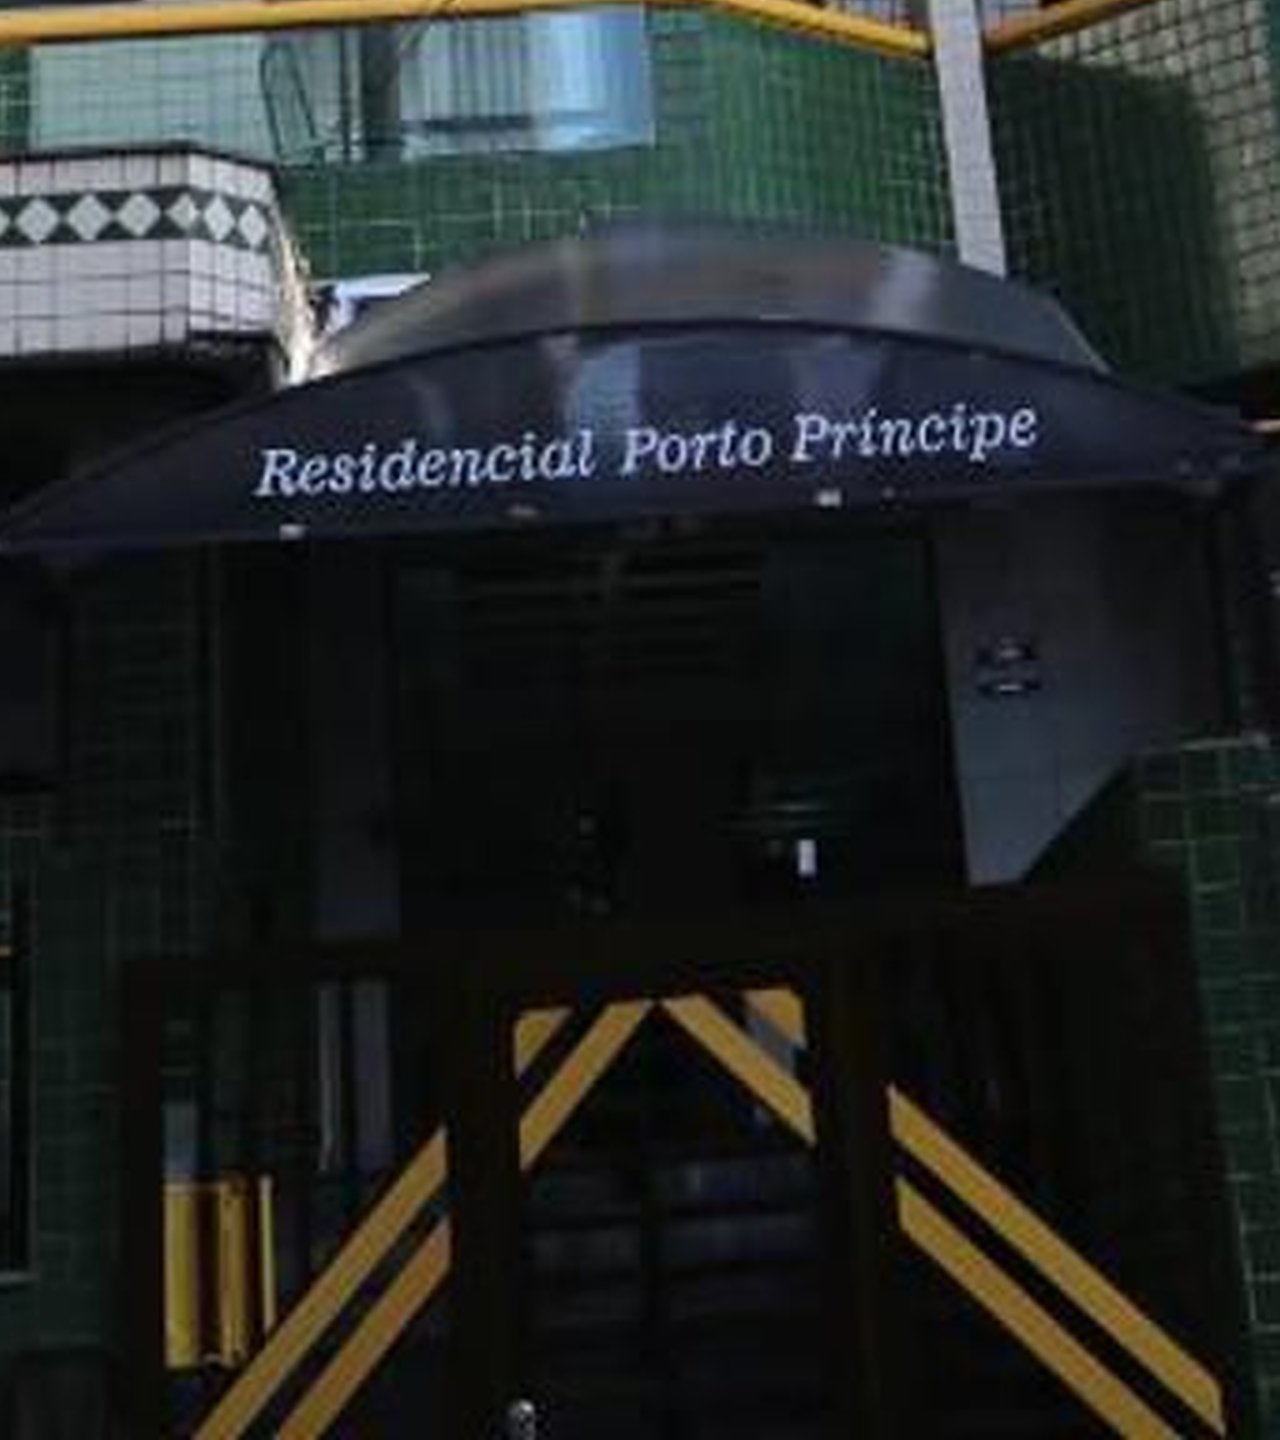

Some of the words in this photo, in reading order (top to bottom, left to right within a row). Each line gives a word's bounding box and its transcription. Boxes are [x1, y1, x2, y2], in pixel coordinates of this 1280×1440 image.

[253, 429, 596, 498] Residencial
[621, 422, 773, 476] Porto
[790, 402, 1038, 463] Príncipe
